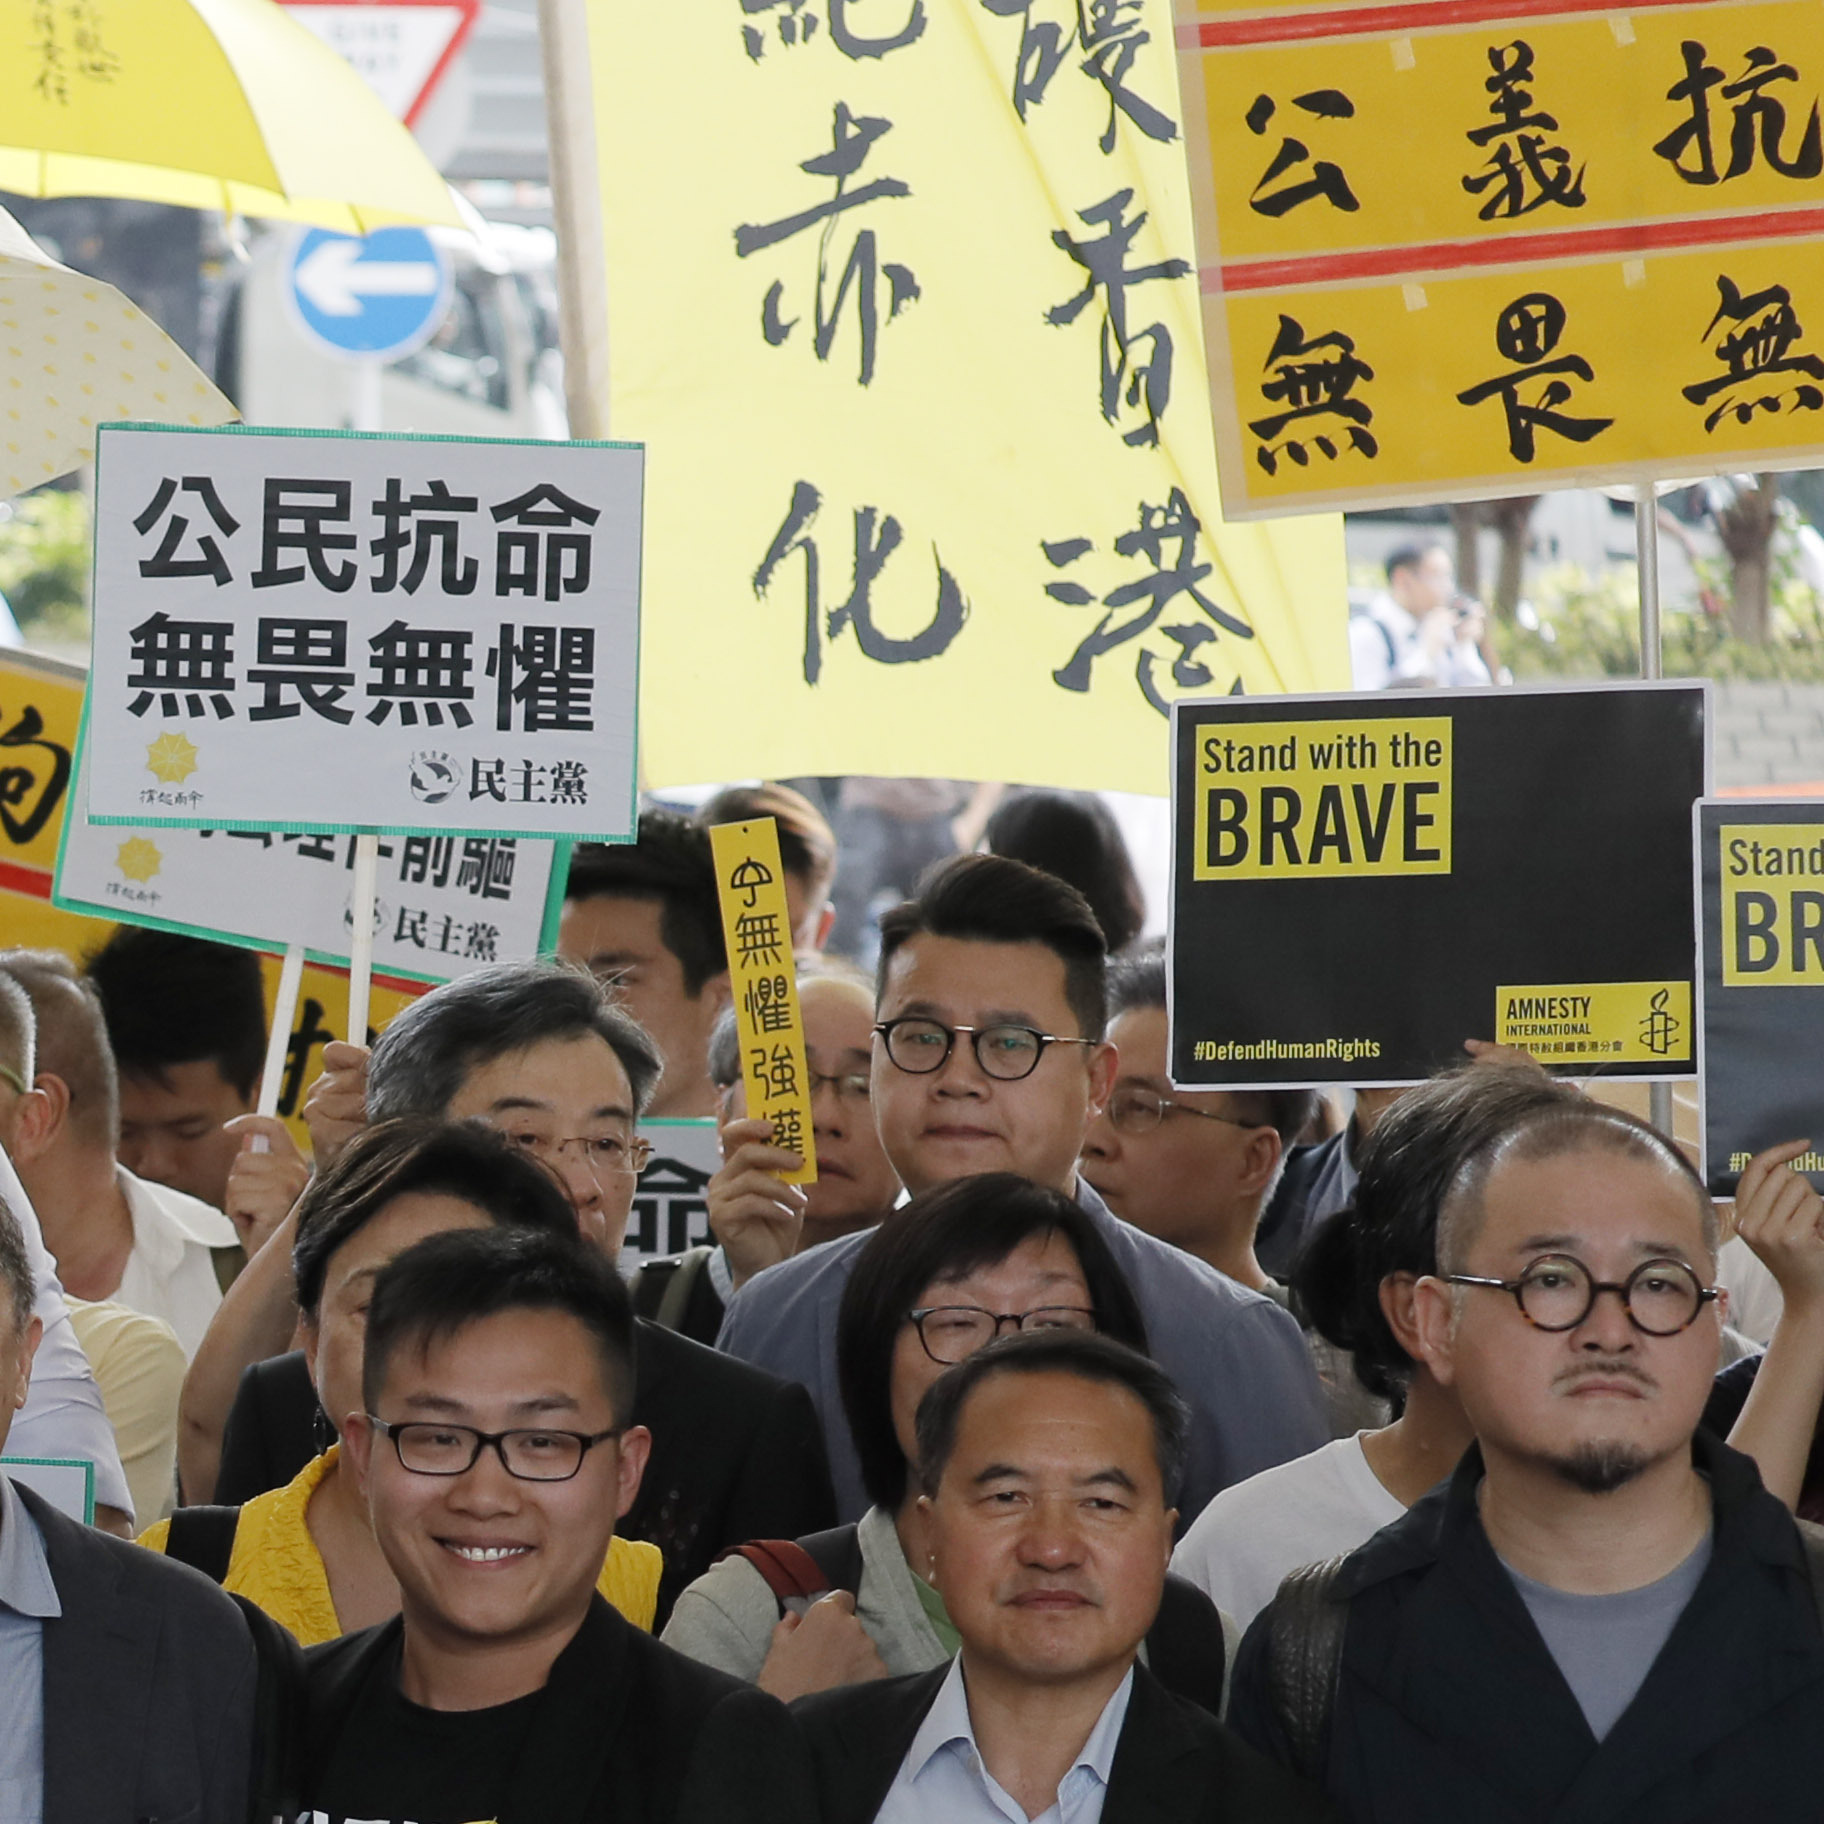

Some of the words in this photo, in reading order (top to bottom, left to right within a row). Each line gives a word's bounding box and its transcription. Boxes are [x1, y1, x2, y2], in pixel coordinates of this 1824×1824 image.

[1244, 38, 1824, 222] 公義抗
[1245, 272, 1824, 476] 無畏無
[133, 475, 601, 602] 公民抗命
[126, 611, 596, 733] 無畏無懼
[468, 757, 590, 806] 民主黨
[1203, 736, 1297, 774] Stand
[1309, 733, 1378, 770] with
[1389, 732, 1442, 768] the
[1206, 782, 1441, 868] BRAVE
[394, 906, 500, 963] 民主黨
[1506, 996, 1592, 1021] AMNESTY
[1506, 1023, 1592, 1036] INTERNATIONAL
[1194, 1039, 1381, 1061] #DefendHumanRights
